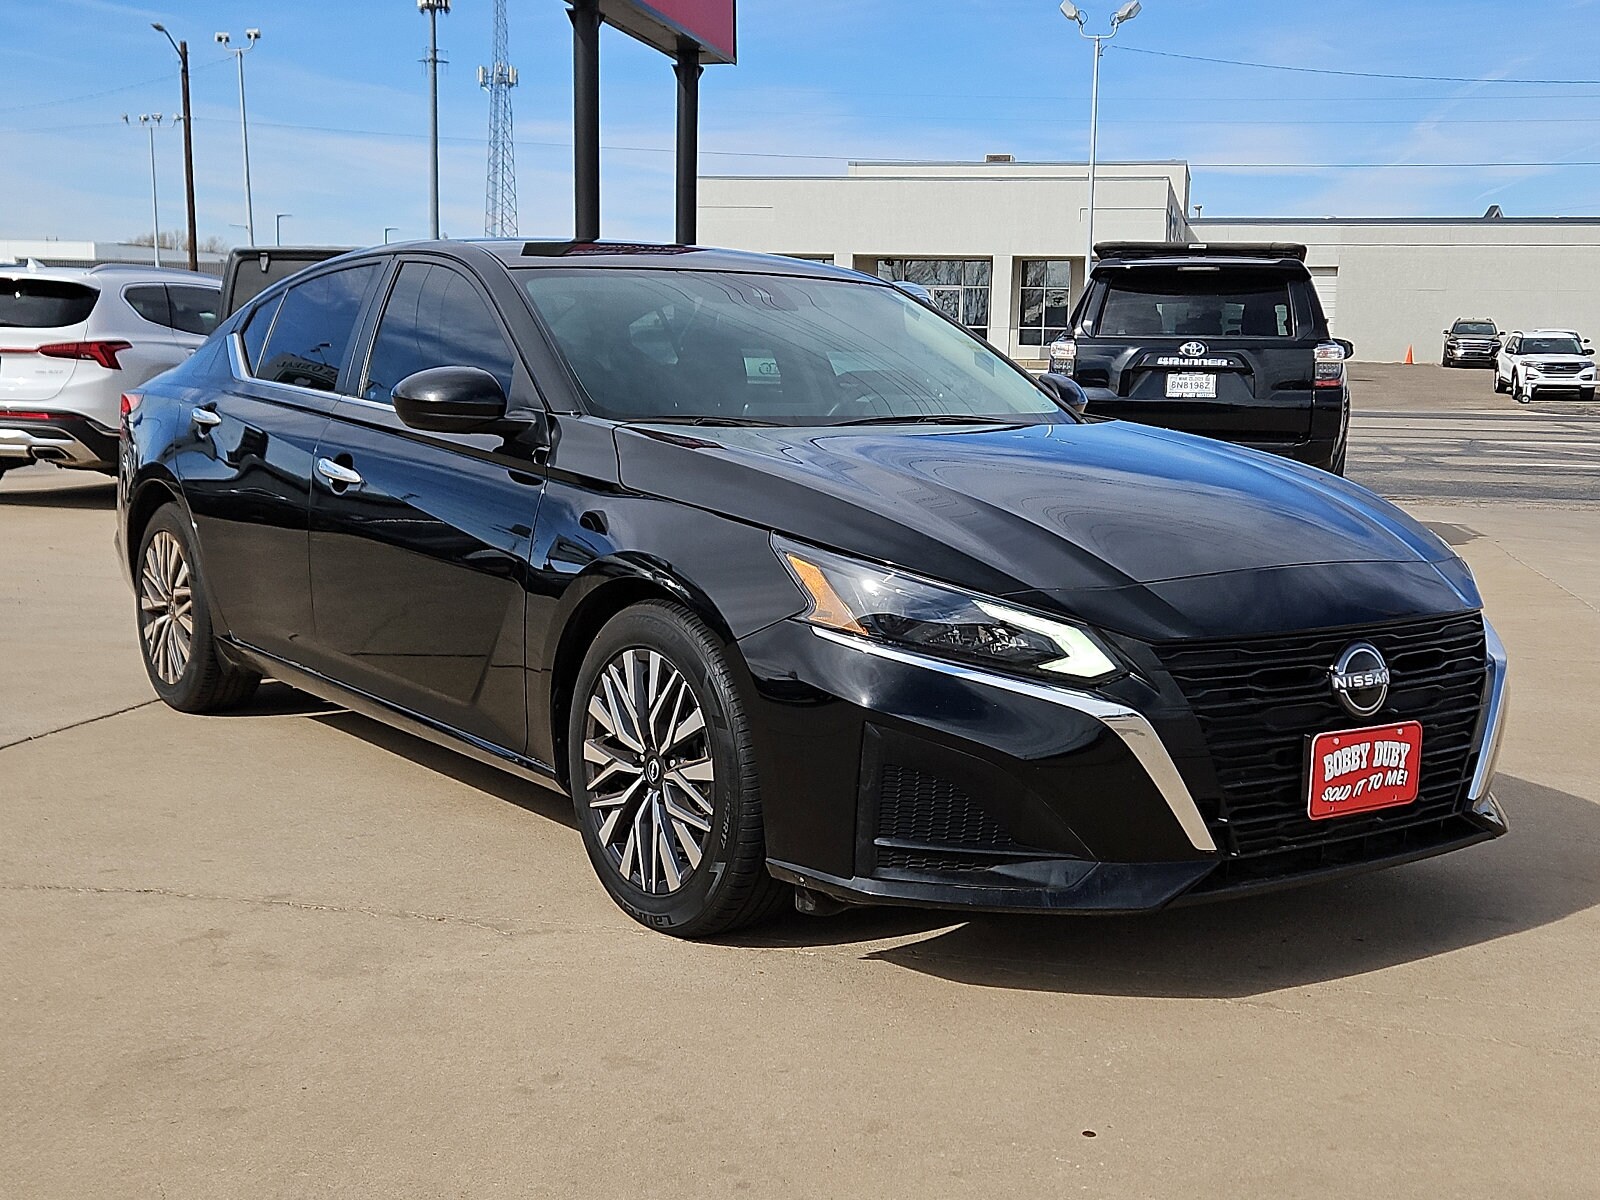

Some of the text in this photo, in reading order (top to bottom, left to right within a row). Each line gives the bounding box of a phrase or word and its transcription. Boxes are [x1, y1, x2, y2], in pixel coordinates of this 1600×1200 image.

[1333, 668, 1390, 689] NISSAN
[1323, 740, 1411, 782] BOBBY DUBY
[1321, 769, 1409, 801] SOLD IT TO ME!
